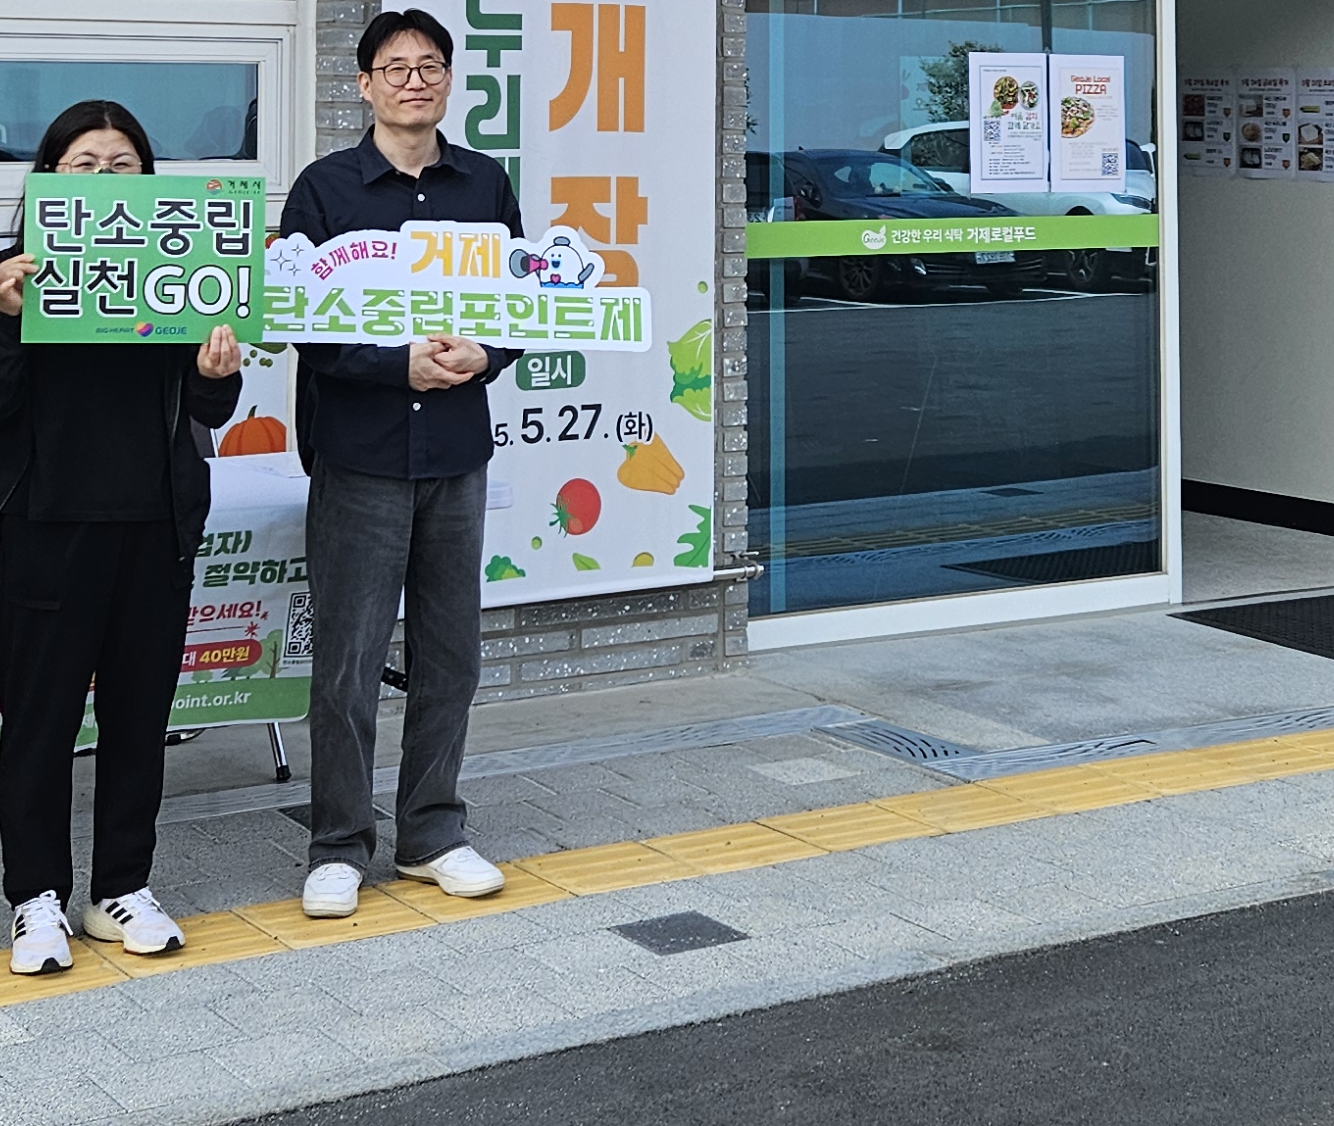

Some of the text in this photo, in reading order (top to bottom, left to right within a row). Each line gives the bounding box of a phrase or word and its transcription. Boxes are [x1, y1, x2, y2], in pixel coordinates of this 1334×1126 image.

[1075, 84, 1106, 94] PIZZA
[36, 197, 253, 258] 탄소중립
[891, 227, 1036, 244] 건강한 우리 식탁 거제로컬푸드
[311, 240, 397, 281] 함께해요!
[410, 231, 501, 277] 거제
[33, 258, 251, 319] 실천 GO!
[263, 285, 643, 342] 탄소중립포인트제
[155, 326, 187, 335] GEOJE
[527, 357, 573, 386] 일시
[202, 557, 308, 588] 절약하고
[199, 646, 250, 663] 40만원
